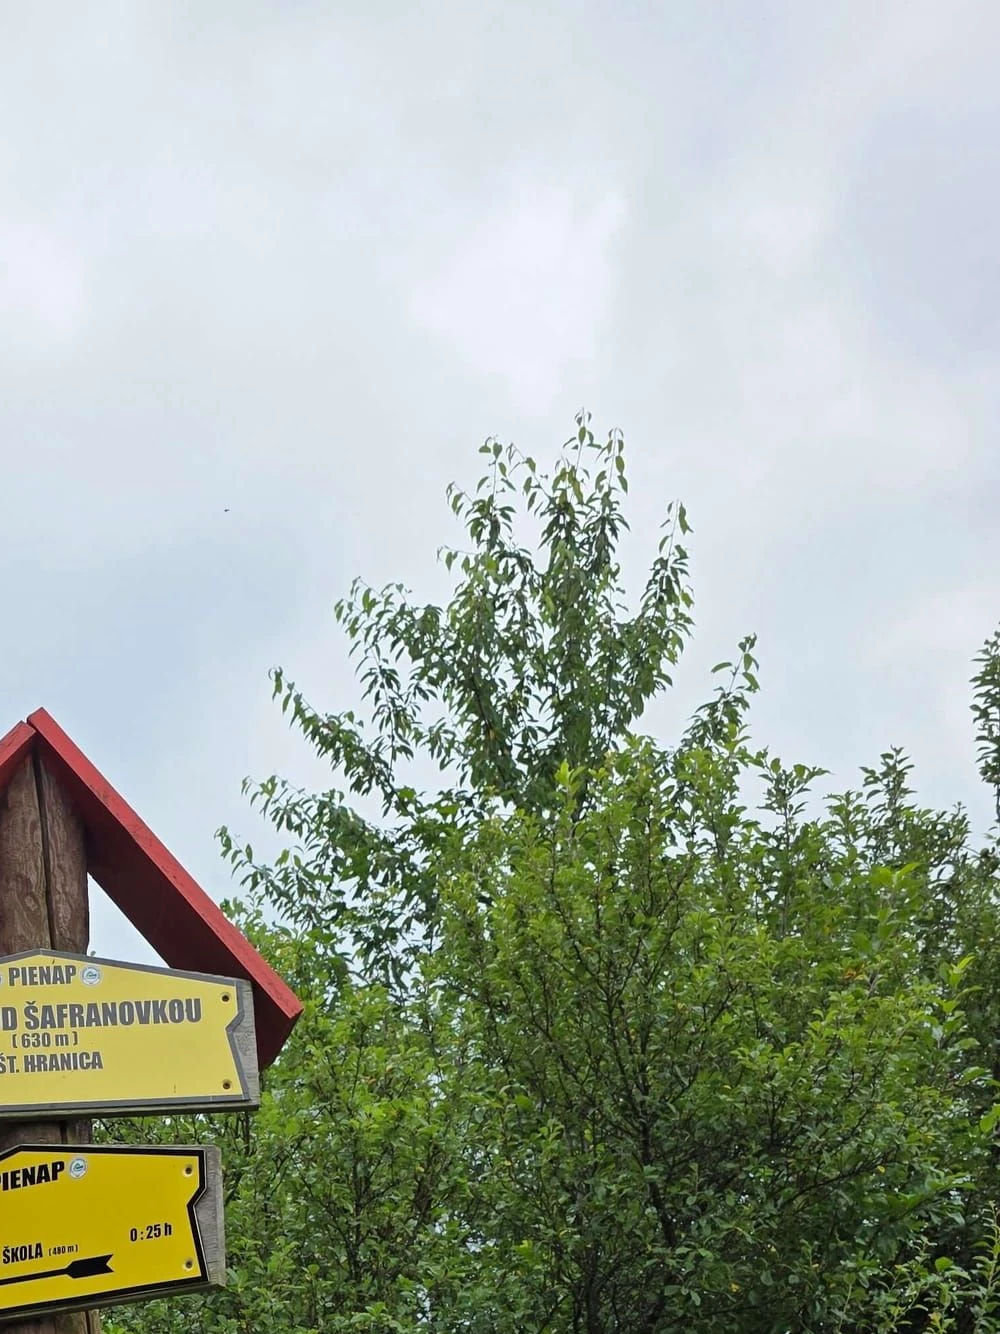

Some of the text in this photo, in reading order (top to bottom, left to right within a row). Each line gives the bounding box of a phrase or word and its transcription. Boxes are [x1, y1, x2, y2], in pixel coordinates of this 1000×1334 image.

[8, 965, 77, 986] PIENAP
[24, 998, 202, 1030] ŠAFRANOVKOU
[23, 1051, 104, 1072] HRANICA
[164, 1223, 172, 1237] h
[2, 1242, 44, 1266] ŠKOLA
